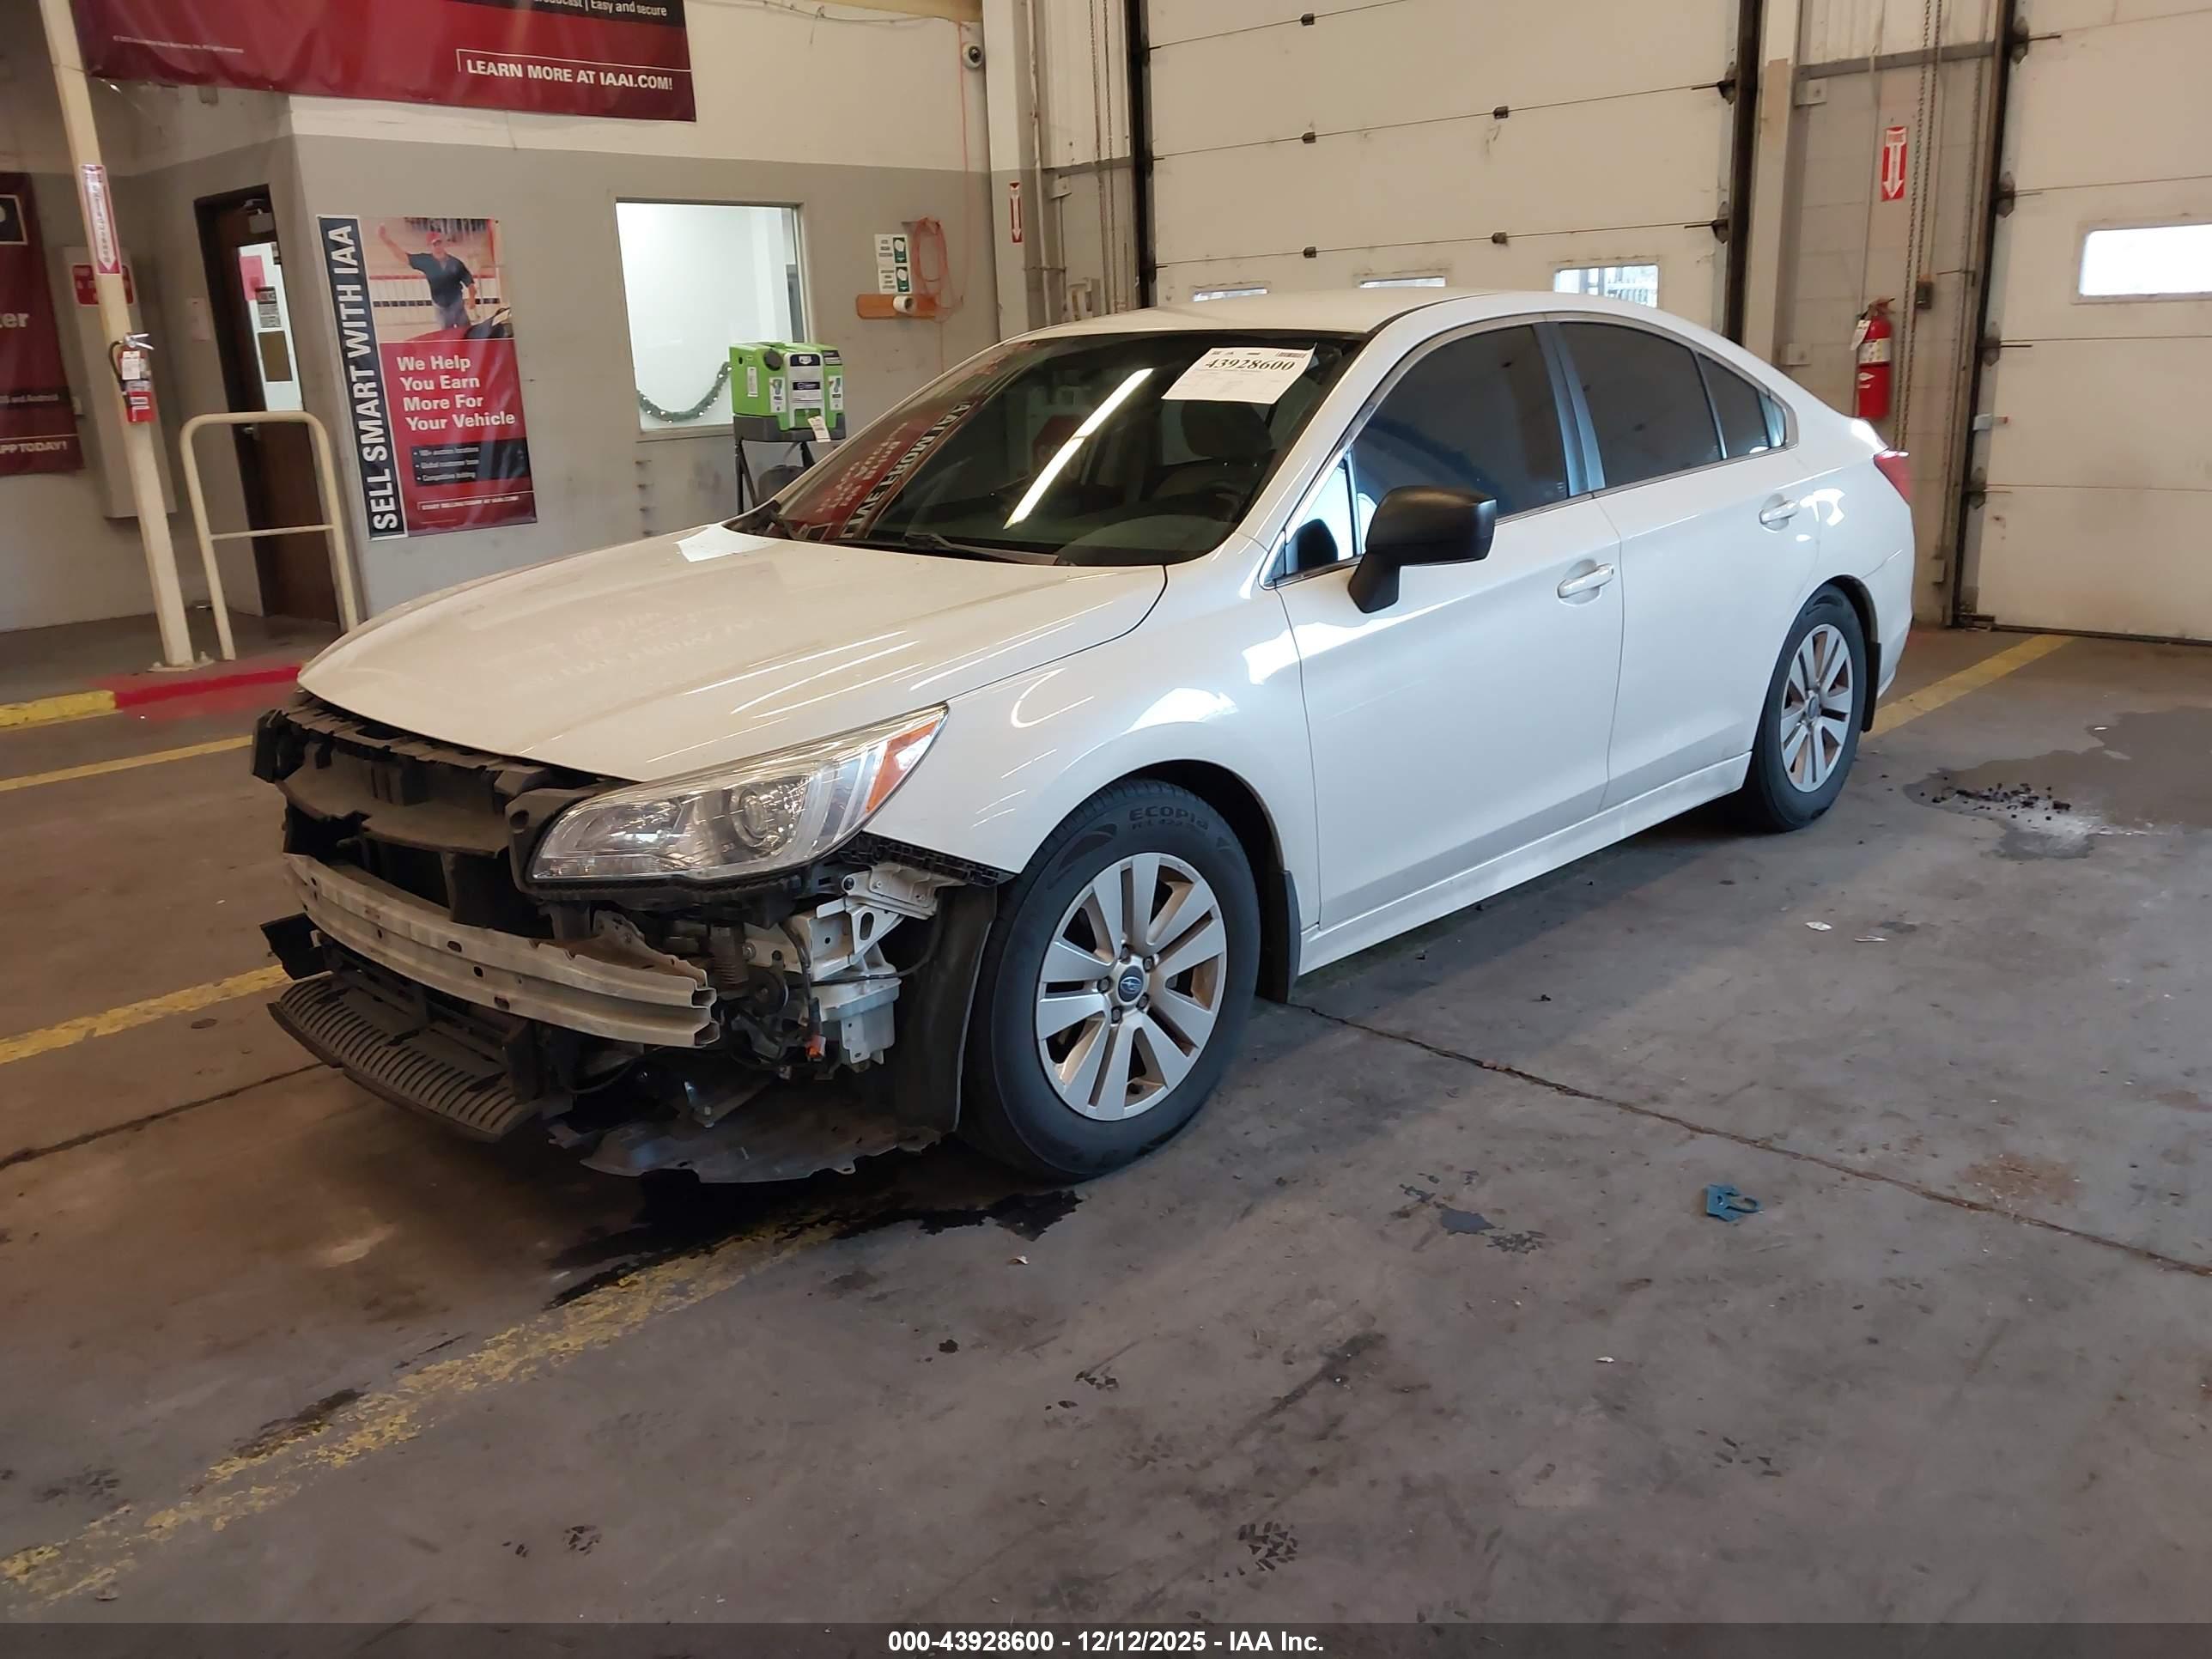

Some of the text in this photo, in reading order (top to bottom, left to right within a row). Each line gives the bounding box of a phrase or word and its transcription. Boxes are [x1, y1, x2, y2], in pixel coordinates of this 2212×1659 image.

[615, 1, 635, 13] and
[636, 4, 667, 16] secure
[466, 59, 673, 90] LEARN MORE AT IAAI.COM!
[397, 355, 471, 372] We Help
[1205, 358, 1296, 371] 43928600
[328, 225, 398, 530] SELL SMART WITH IAA
[399, 375, 480, 392] You Earn
[403, 394, 483, 412] More For
[405, 411, 516, 432] Your Vehicle
[18, 441, 68, 453] TODAY!
